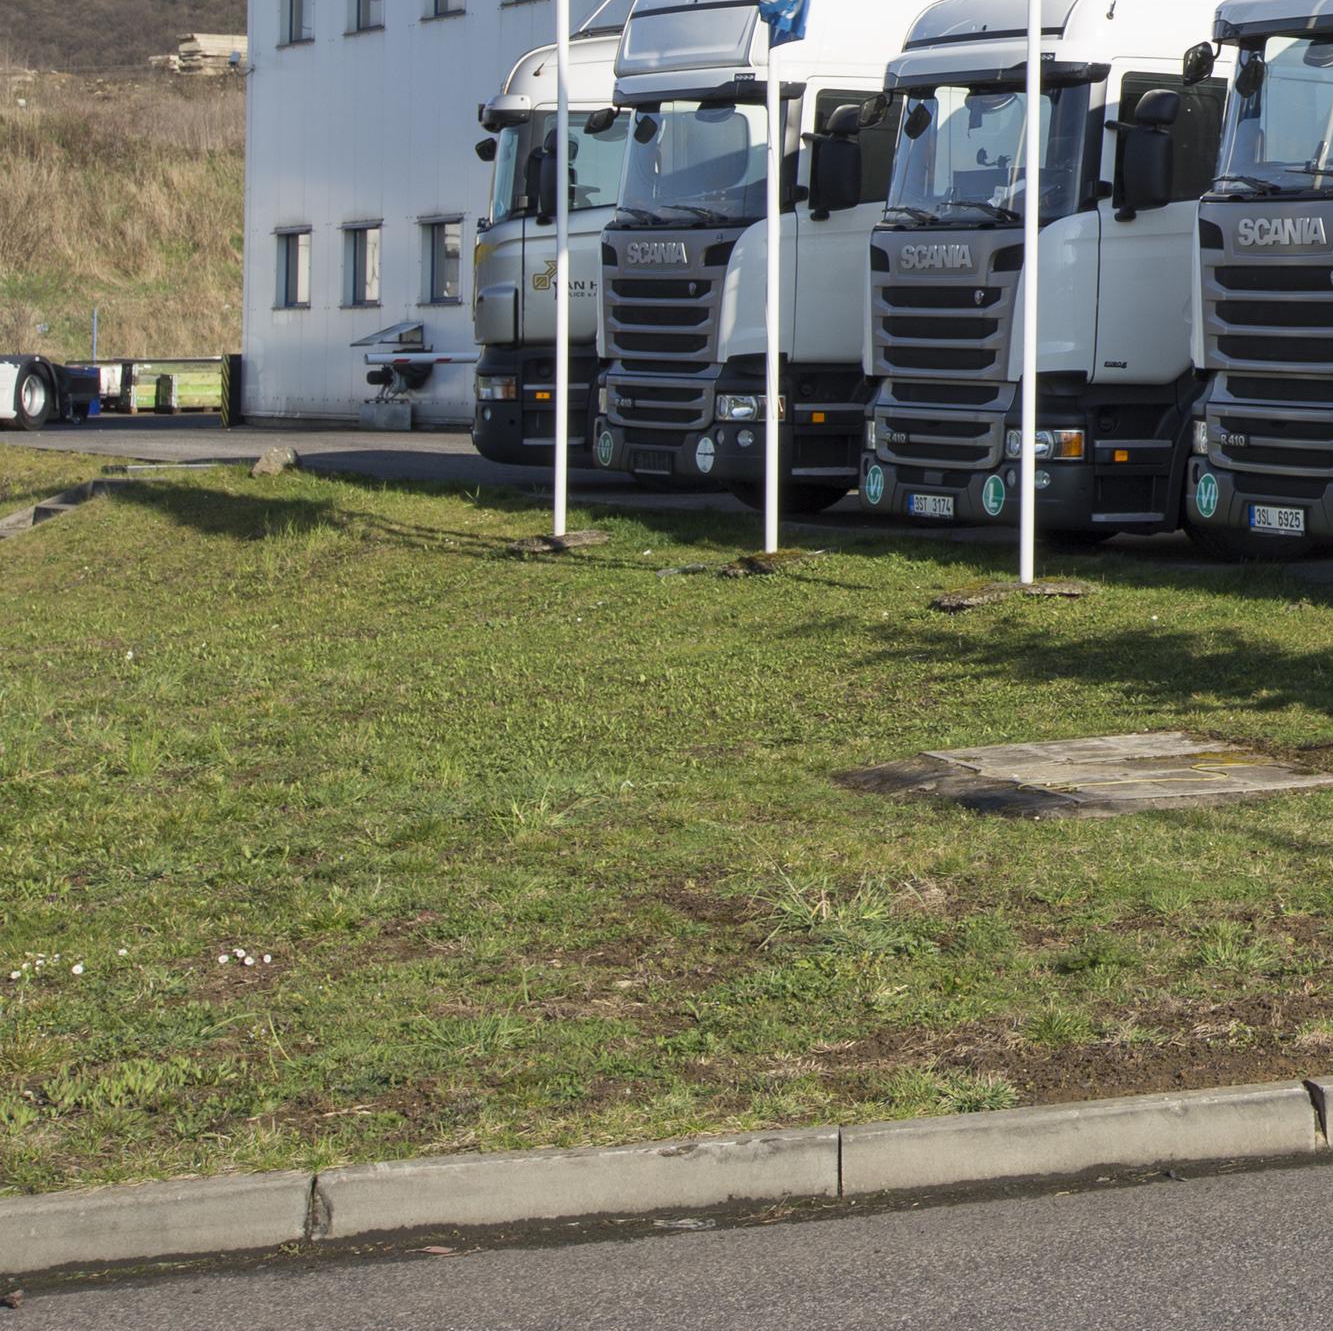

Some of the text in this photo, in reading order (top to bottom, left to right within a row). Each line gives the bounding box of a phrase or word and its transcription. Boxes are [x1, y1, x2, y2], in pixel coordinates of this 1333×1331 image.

[1238, 217, 1327, 246] SCANIA
[627, 242, 688, 264] SCANIA
[901, 245, 972, 269] SCANIA
[1220, 434, 1245, 447] R 410
[915, 496, 951, 514] 3ST 3174
[1256, 508, 1301, 528] 3SL 6925
